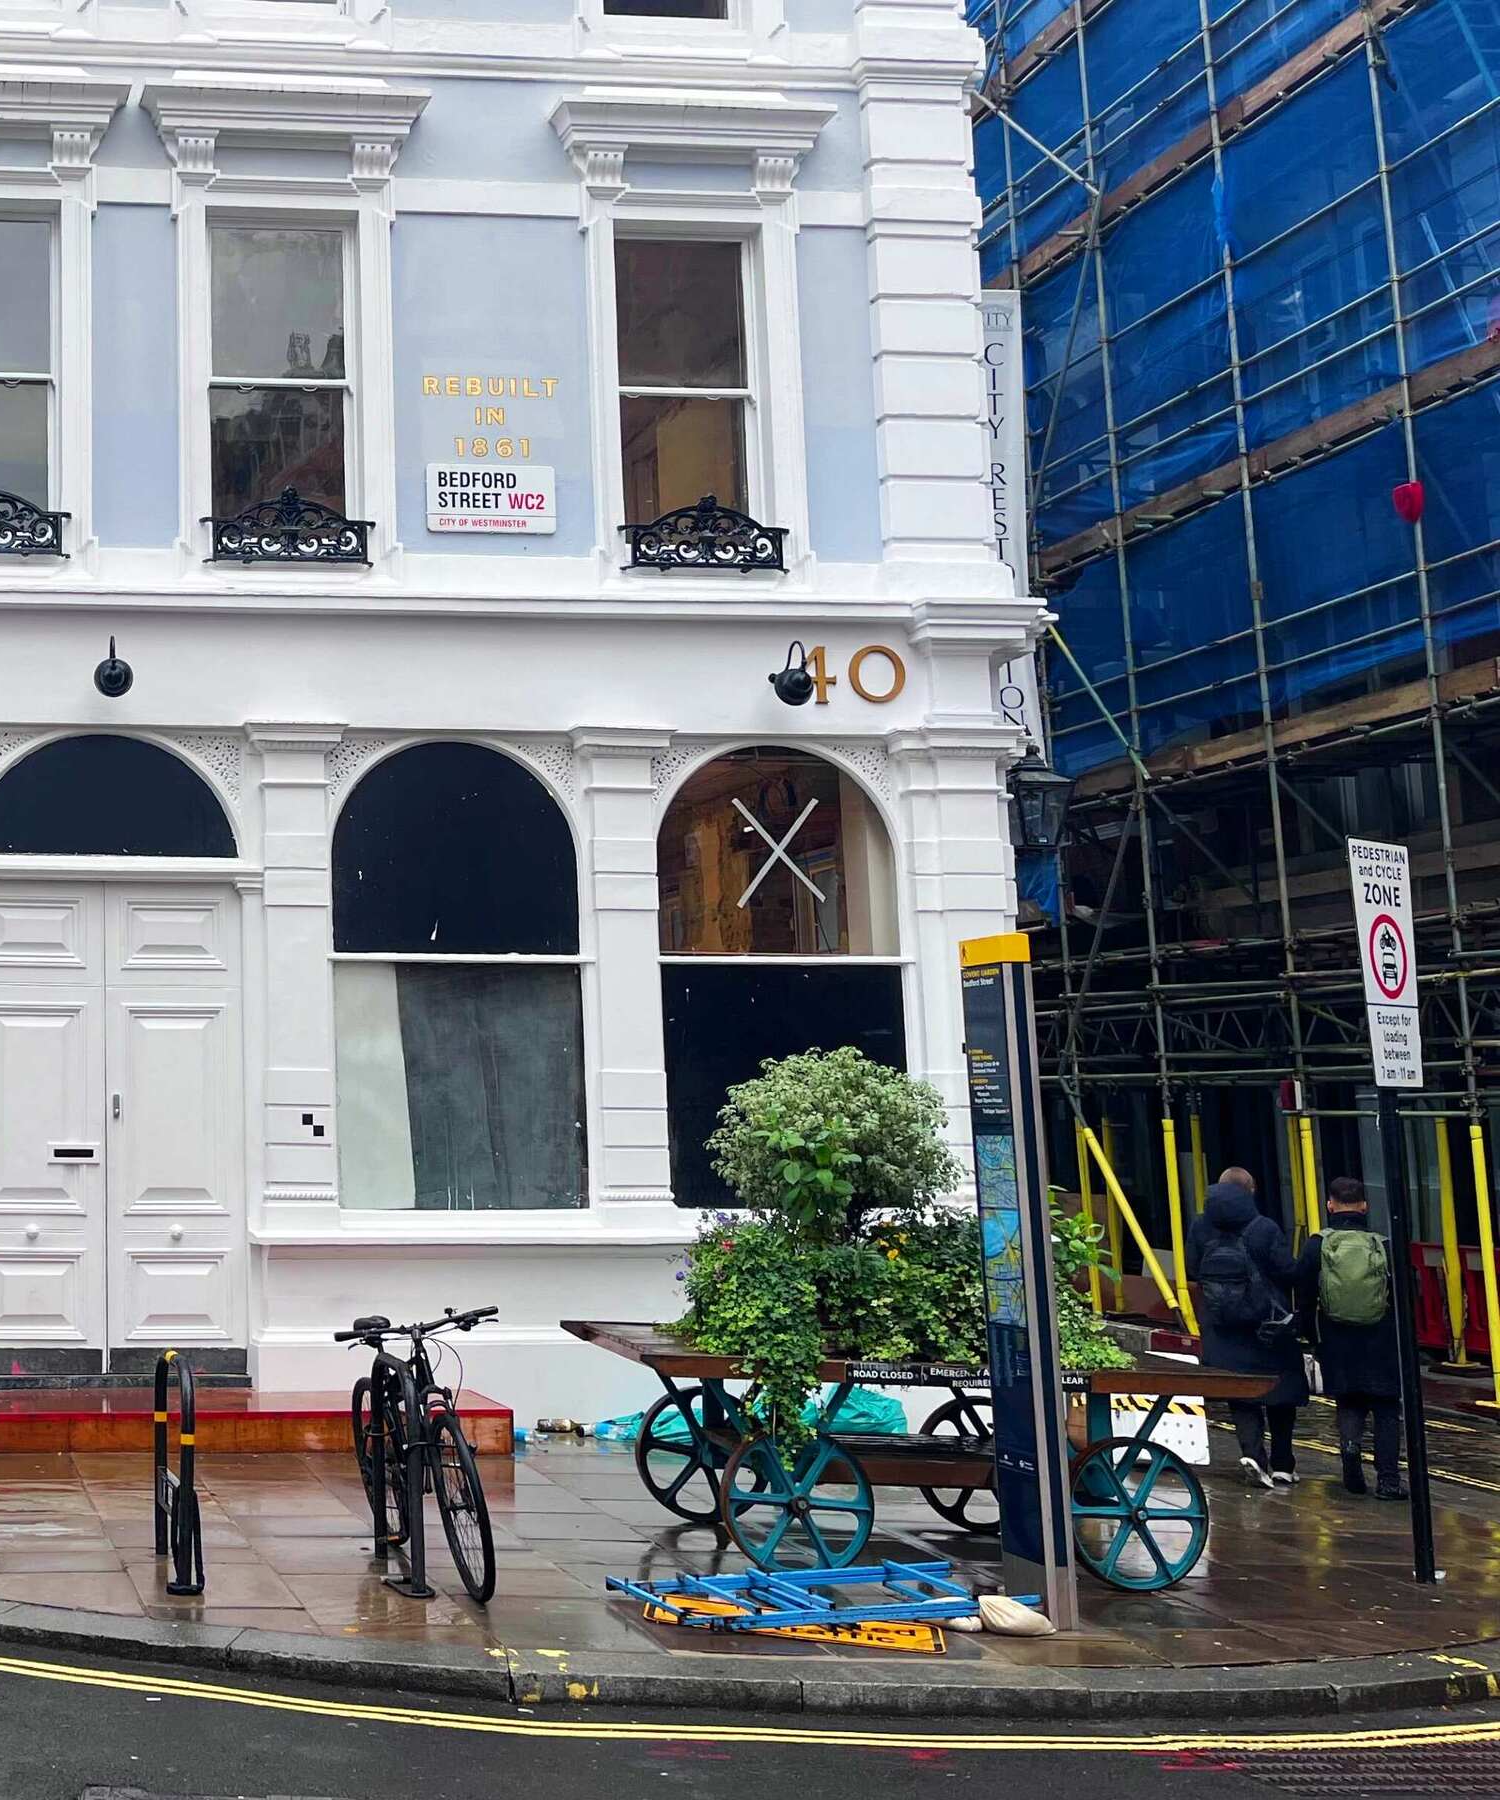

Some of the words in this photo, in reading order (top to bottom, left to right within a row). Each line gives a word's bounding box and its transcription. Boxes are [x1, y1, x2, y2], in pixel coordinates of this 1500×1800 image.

[984, 312, 1012, 327] ITY
[422, 375, 559, 398] REBUILT
[984, 342, 1004, 440] CITY
[475, 407, 505, 426] IN
[454, 437, 531, 458] 1861
[438, 471, 517, 489] BEDFORD
[438, 492, 502, 509] STREET
[508, 493, 545, 510] WC2
[439, 518, 456, 527] CITY
[458, 518, 469, 527] OF
[471, 518, 527, 528] WESTMINSTER
[806, 645, 906, 704] 40
[1351, 844, 1406, 864] PEDESTRIAN
[1359, 864, 1373, 877] and
[1375, 865, 1402, 880] CYCLE
[1363, 882, 1401, 907] ZONE
[1377, 1011, 1400, 1027] Except
[1401, 1013, 1411, 1026] for
[1383, 1030, 1407, 1046] loading
[1384, 1046, 1411, 1061] between
[853, 1369, 878, 1378] ROAD
[880, 1371, 914, 1379] CLOSED
[930, 1367, 981, 1378] EMERGENY
[1061, 1376, 1084, 1385] LEAR
[952, 1378, 991, 1388] REQUIRE
